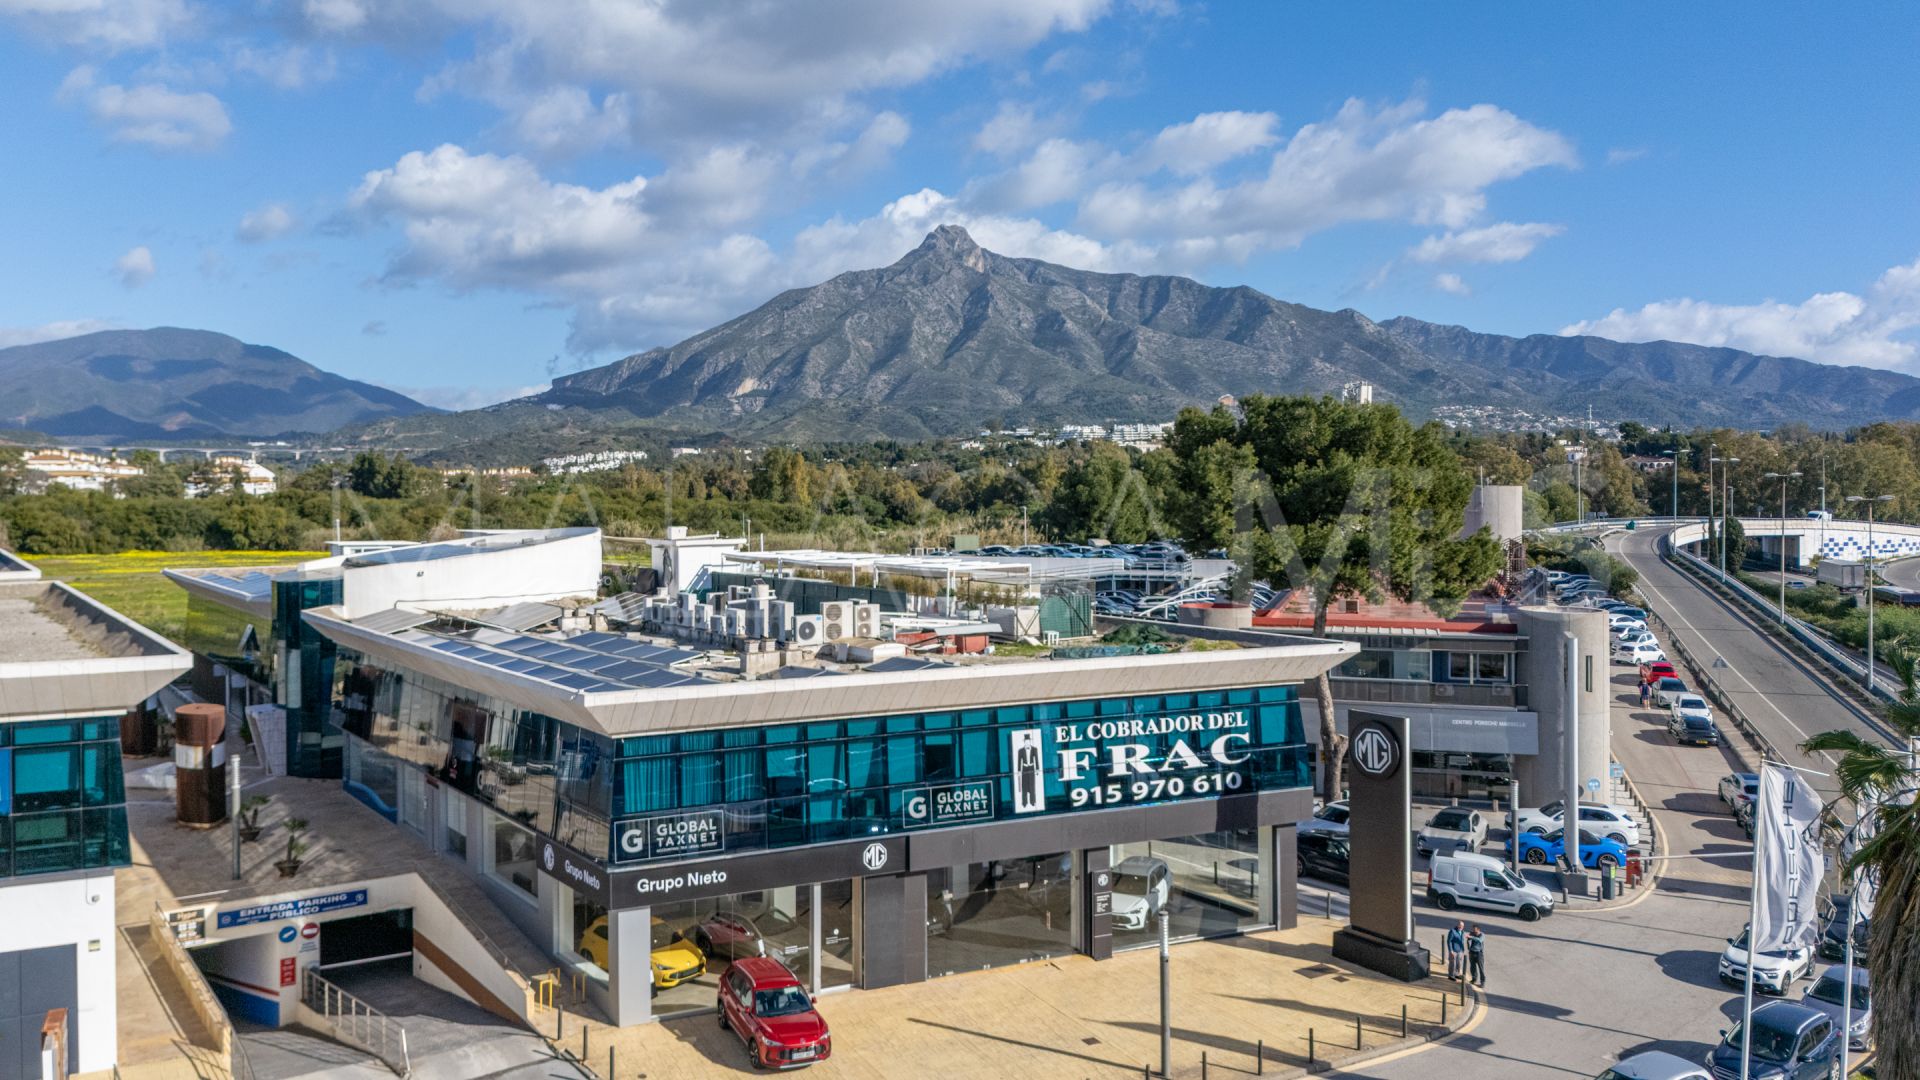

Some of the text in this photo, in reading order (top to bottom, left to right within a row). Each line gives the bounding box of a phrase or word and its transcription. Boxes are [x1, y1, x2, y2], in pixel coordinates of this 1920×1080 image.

[1055, 711, 1248, 743] EL COBRADOR DEL
[1057, 732, 1251, 782] FRAC
[1356, 730, 1390, 772] MG
[937, 788, 987, 804] GLOBAL
[1071, 771, 1242, 807] 915 970 610
[908, 796, 927, 819] G
[936, 800, 988, 815] TAXNET
[656, 818, 717, 836] GLOBAL
[621, 829, 643, 853] G
[656, 832, 717, 848] TAXNET
[864, 844, 886, 869] MG
[564, 861, 601, 891] Grupo Nieto
[637, 870, 727, 893] Grupo Nieto
[240, 901, 294, 917] ENTRADA
[298, 894, 347, 909] PARKING
